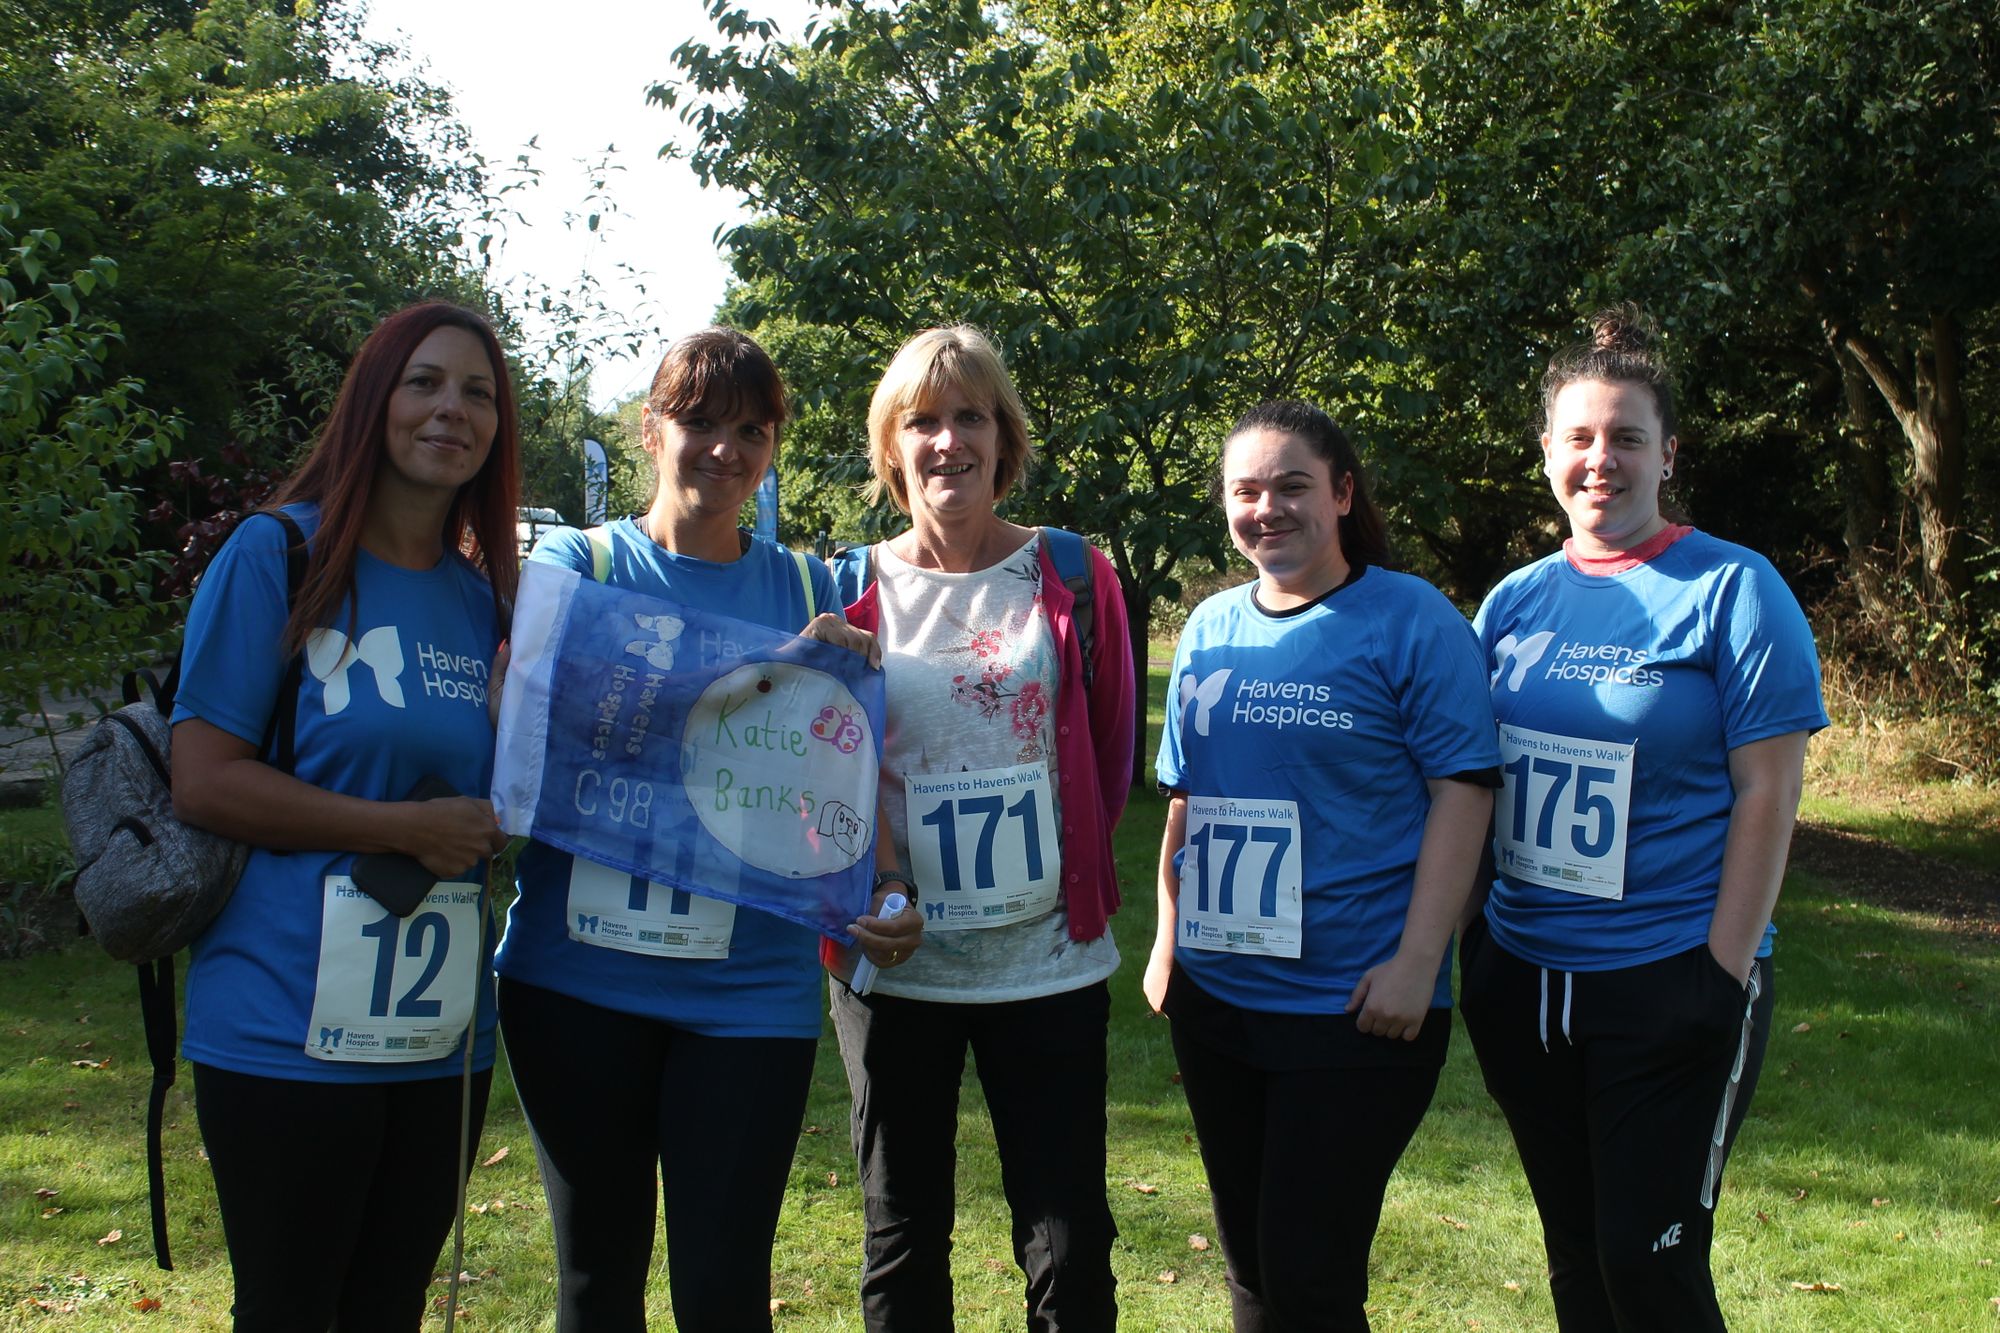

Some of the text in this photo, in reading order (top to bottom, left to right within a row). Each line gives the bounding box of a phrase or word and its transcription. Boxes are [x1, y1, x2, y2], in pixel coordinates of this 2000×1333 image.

[417, 641, 488, 679] Haven
[1556, 641, 1648, 663] Havens
[1544, 661, 1664, 687] Hospices
[422, 671, 488, 707] Hospi
[1236, 679, 1331, 702] Havens
[716, 694, 807, 756] Katie
[1232, 701, 1354, 730] Hospices
[1506, 732, 1625, 763] Havens to Havens Walk
[715, 768, 816, 815] Banks
[913, 770, 1043, 795] Havens to Havens Walk
[1192, 804, 1294, 820] Havens to Havens Walk
[1504, 754, 1616, 858] 175
[922, 789, 1043, 892] 171
[1190, 822, 1292, 918] 177
[336, 885, 370, 899] Have
[602, 919, 628, 930] Havens
[948, 909, 978, 917] Hospices
[601, 926, 633, 938] Hospices
[361, 911, 451, 1017] 12
[345, 1038, 380, 1047] Hospices
[347, 1031, 375, 1040] Havens
